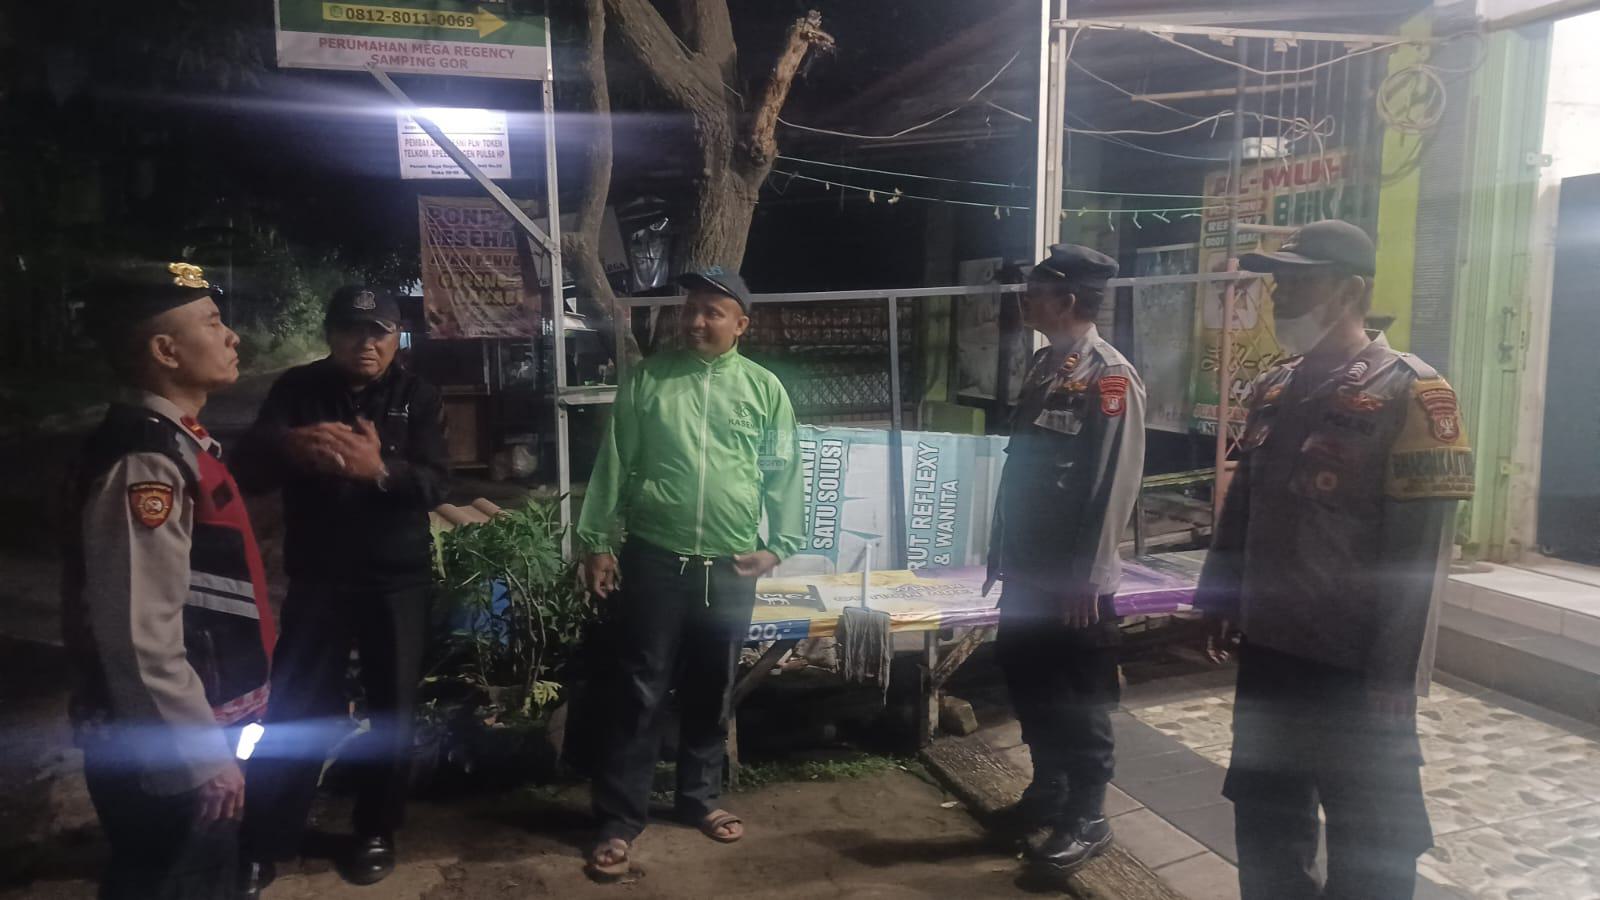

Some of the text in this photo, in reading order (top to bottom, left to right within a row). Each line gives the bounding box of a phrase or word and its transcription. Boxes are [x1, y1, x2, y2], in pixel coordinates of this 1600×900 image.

[345, 7, 475, 28] 0812-8011-0069
[319, 37, 515, 59] PERUMAHAN MEGA REGENCY
[370, 54, 469, 70] SAMPING GOR
[812, 439, 843, 550] SATU SOLUSI
[911, 441, 940, 530] REFLEXY
[934, 479, 959, 566] & WANITA
